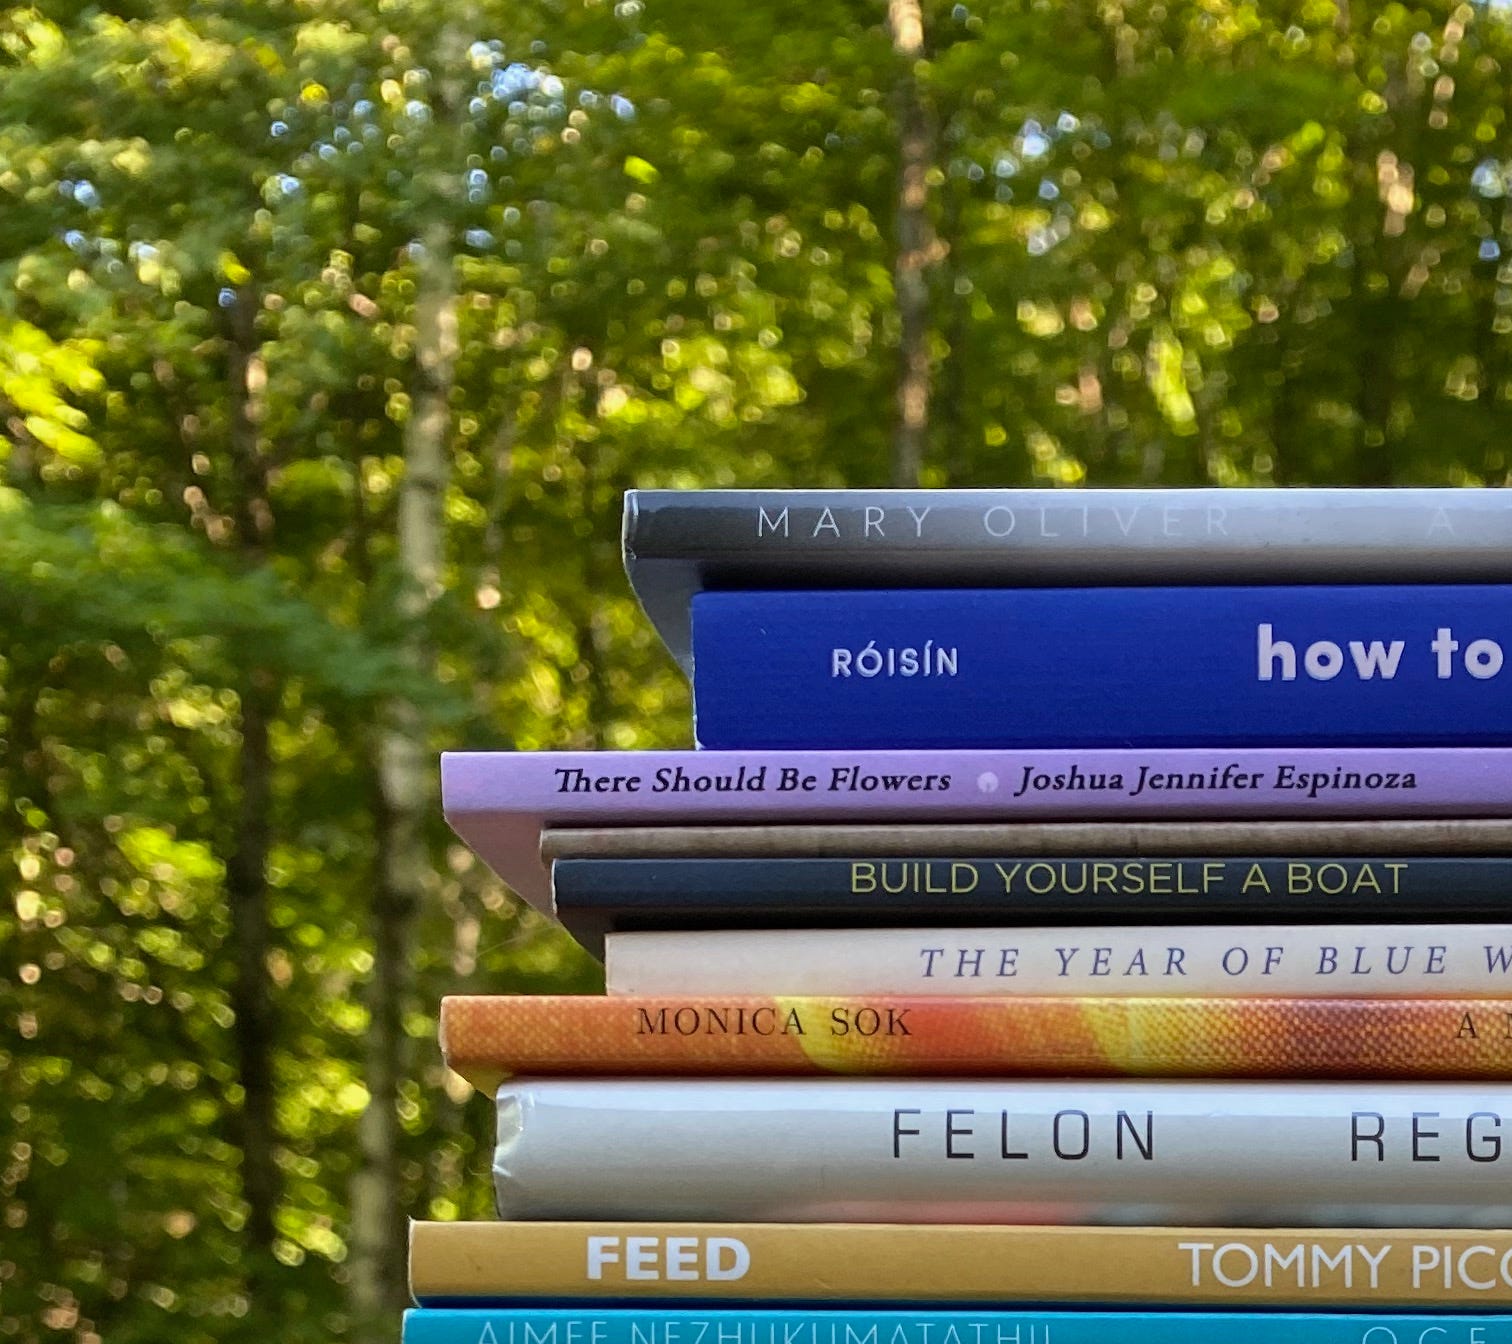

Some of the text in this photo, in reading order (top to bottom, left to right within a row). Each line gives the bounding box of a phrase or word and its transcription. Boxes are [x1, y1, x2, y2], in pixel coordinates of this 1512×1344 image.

[756, 506, 931, 538] MARY
[832, 639, 958, 678] RÓISÍN
[556, 767, 950, 793] There Should Be Flowers
[1015, 764, 1417, 798] Joshua Jennifer Espinoza
[921, 948, 1019, 978] THE
[1056, 948, 1189, 977] YEAR
[1222, 947, 1284, 975] OF
[1316, 946, 1448, 974] BLUE
[636, 1007, 912, 1036] MONICA SOK
[893, 1109, 1153, 1160] FELON
[587, 1237, 750, 1281] FEED
[1179, 1243, 1391, 1289] TOMMY
